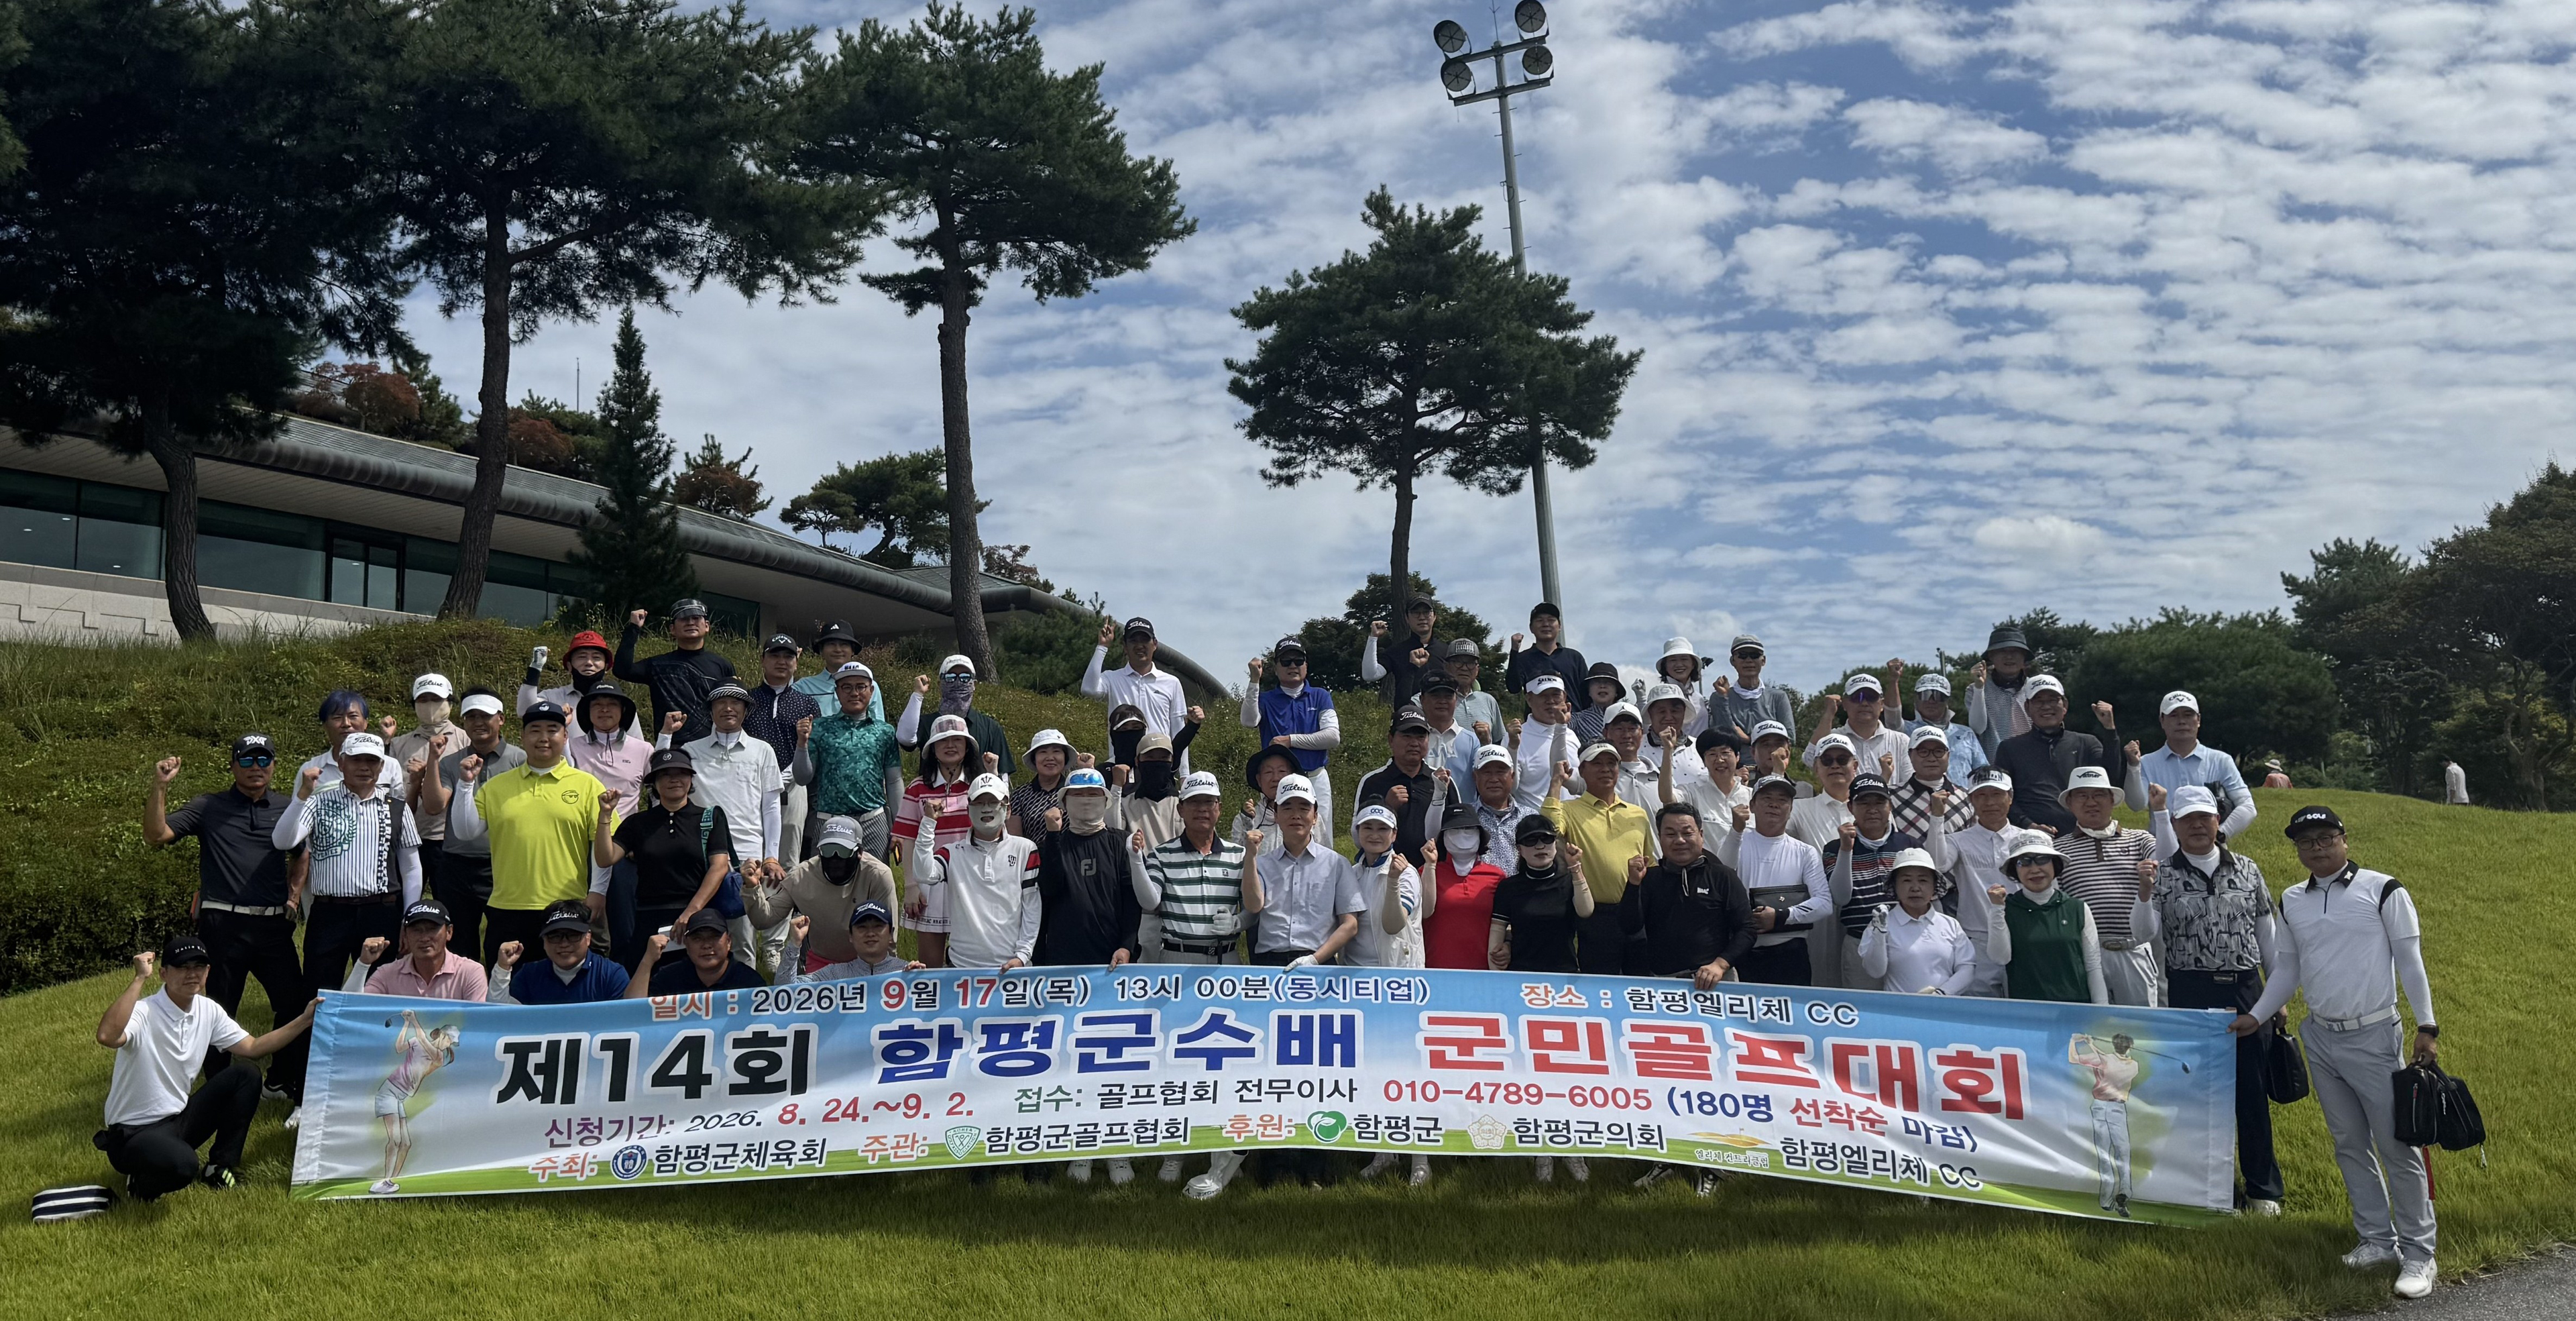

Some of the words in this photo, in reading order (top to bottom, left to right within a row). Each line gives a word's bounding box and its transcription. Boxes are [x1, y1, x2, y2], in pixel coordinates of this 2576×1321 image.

[417, 679, 443, 689] Titleist
[1400, 711, 1425, 721] Titleist
[352, 735, 380, 746] Titleist
[1479, 749, 1505, 760] Titleist
[1184, 779, 1215, 790] Titleist
[1281, 783, 1309, 794] Titleist
[1854, 778, 1885, 790] Titleist
[824, 824, 854, 835] Titleist
[1080, 858, 1097, 876] FJ
[407, 904, 440, 916] Titleist
[856, 903, 886, 914] Titleist
[651, 992, 710, 1019] 일시
[753, 983, 864, 1012] 2026년
[883, 980, 938, 1009] 9월
[956, 977, 1090, 1006] 17일(목)
[1117, 976, 1180, 999] 13시
[1197, 975, 1429, 1004] 00분(동시티업)
[1523, 985, 1585, 1007] 장소
[1628, 988, 1791, 1023] 함평엘리체
[1809, 1002, 1858, 1026] CC
[496, 1029, 810, 1105] 제14회
[877, 1013, 1357, 1084] 함평군수배
[1423, 1015, 2024, 1120] 군민골프대회
[545, 1114, 675, 1149] 신청기간:
[686, 1110, 762, 1132] 2026.
[778, 1104, 806, 1125] 8.
[822, 1093, 930, 1123] 24.~9.
[946, 1092, 973, 1116] 2.
[1014, 1085, 1082, 1114] 접수:
[1097, 1079, 1218, 1110] 골프협회
[1235, 1077, 1357, 1103] 전무이사
[1384, 1079, 1653, 1111] 010-4789-6005
[1667, 1086, 1774, 1123] (180명
[1789, 1097, 1889, 1137] 선착순
[1902, 1116, 1978, 1153] 마감)
[986, 1117, 1188, 1153] 함평군골프협회
[1226, 1114, 1293, 1139] 후원:
[1353, 1114, 1443, 1143] 함평군
[1513, 1118, 1664, 1151] 함평군의회
[531, 1151, 598, 1180] 주최:
[655, 1138, 828, 1174] 함평군체육회
[860, 1132, 928, 1161] 주관:
[1779, 1138, 1928, 1183] 함평엘리체
[1939, 1165, 1980, 1190] CC
